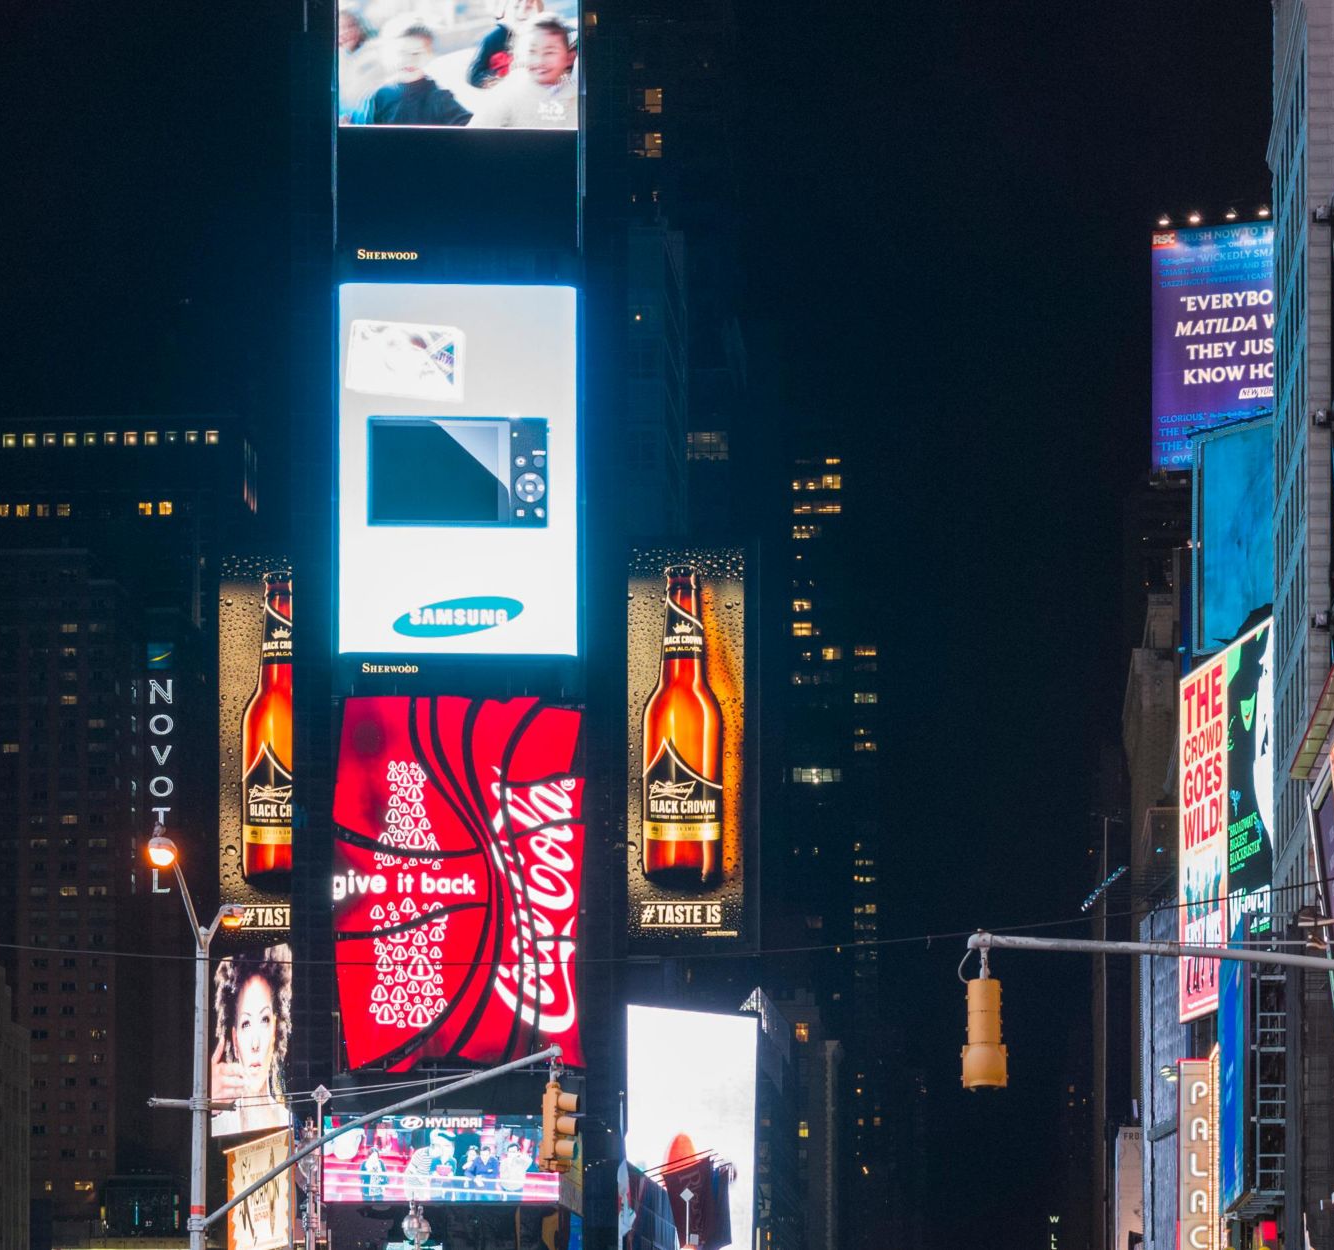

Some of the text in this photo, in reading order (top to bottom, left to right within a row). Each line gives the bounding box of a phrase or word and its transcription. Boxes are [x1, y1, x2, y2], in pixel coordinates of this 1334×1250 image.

[1175, 316, 1258, 337] MATILDA
[1186, 337, 1274, 360] THEY JUS
[1184, 365, 1245, 385] KNOW
[409, 608, 509, 626] SAMSUNG
[1184, 663, 1223, 735] THE
[1184, 719, 1223, 768] CROWD
[149, 679, 174, 894] NOVOTL
[1184, 751, 1223, 809] GOES
[249, 804, 278, 818] BLACK
[650, 800, 716, 814] BLACK CROWN
[1183, 793, 1224, 851] WILD!
[332, 869, 476, 900] give it back
[641, 905, 722, 924] #TASTE IS
[425, 1117, 483, 1128] HYUNDAI
[1190, 1081, 1208, 1249] PALAC
